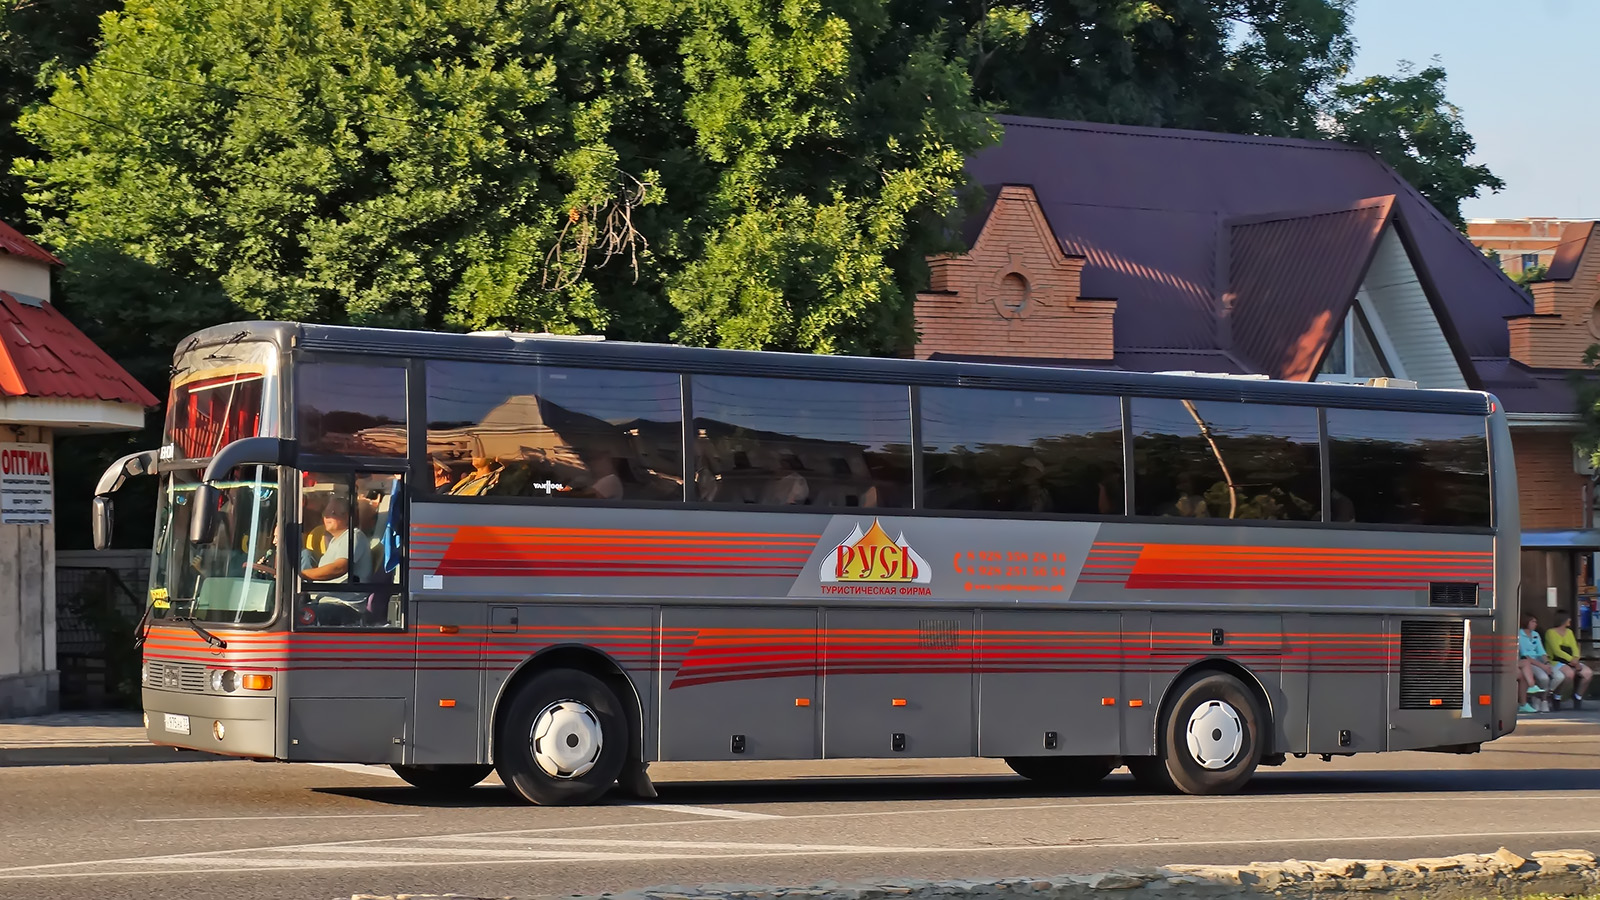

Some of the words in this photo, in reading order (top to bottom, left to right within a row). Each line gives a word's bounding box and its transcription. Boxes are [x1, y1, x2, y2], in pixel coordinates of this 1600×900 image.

[2, 449, 50, 476] ОПТИКА
[835, 545, 919, 579] РУСЬ
[821, 586, 897, 595] ТУРИСТИЧЕСКАЯ
[899, 587, 932, 596] ФИРМА
